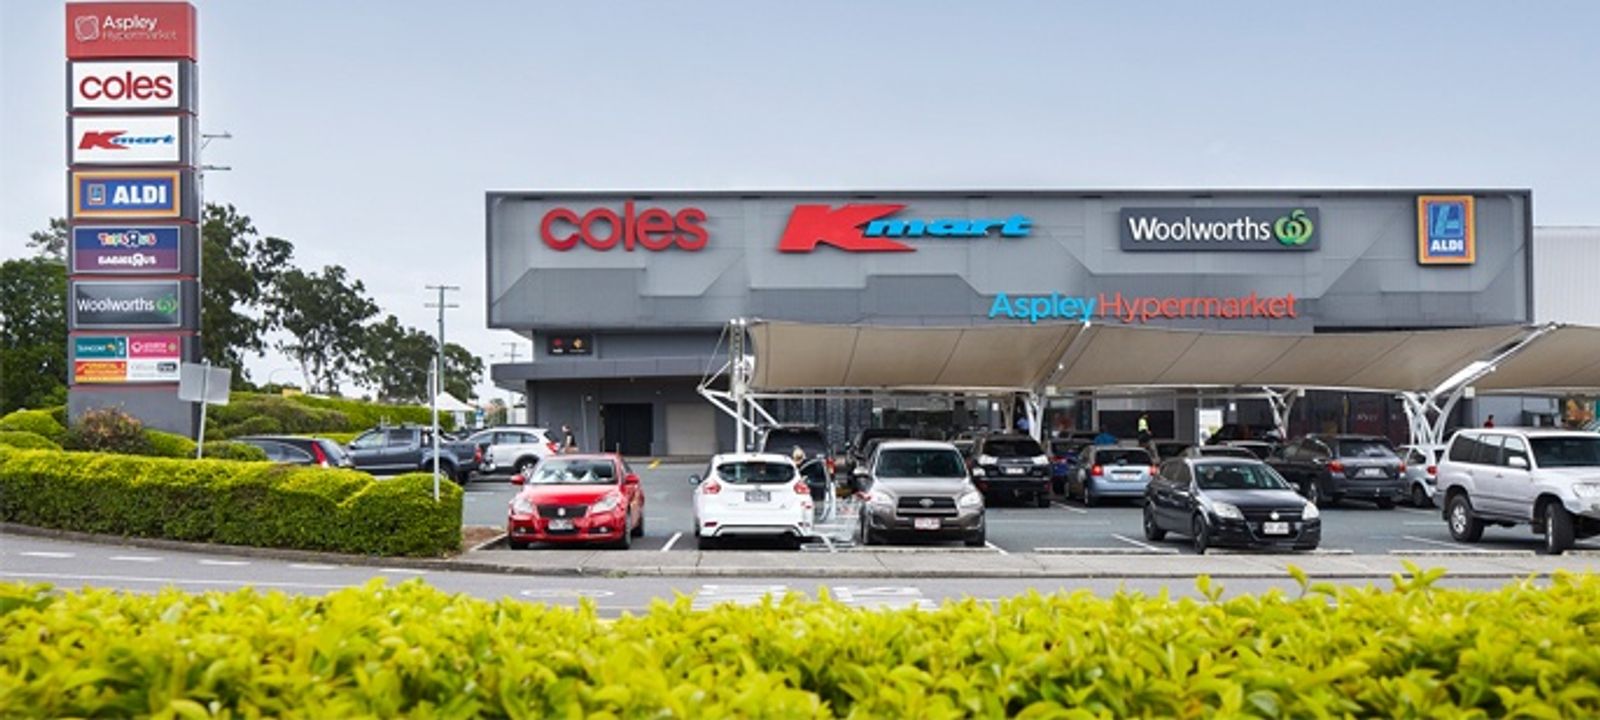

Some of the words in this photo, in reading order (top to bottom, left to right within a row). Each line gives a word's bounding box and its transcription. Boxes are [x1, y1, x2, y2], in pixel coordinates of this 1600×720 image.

[103, 15, 159, 32] Aspley
[79, 72, 174, 101] coles
[78, 131, 175, 149] Kmart
[113, 186, 166, 204] ALDI
[541, 200, 707, 252] coles
[778, 203, 1033, 253] Kmart
[1128, 214, 1271, 242] Woolworths
[1431, 239, 1463, 252] ALDI
[76, 297, 155, 312] Woolworths
[990, 291, 1096, 324] Aspley
[1098, 292, 1297, 322] Hypermarket
